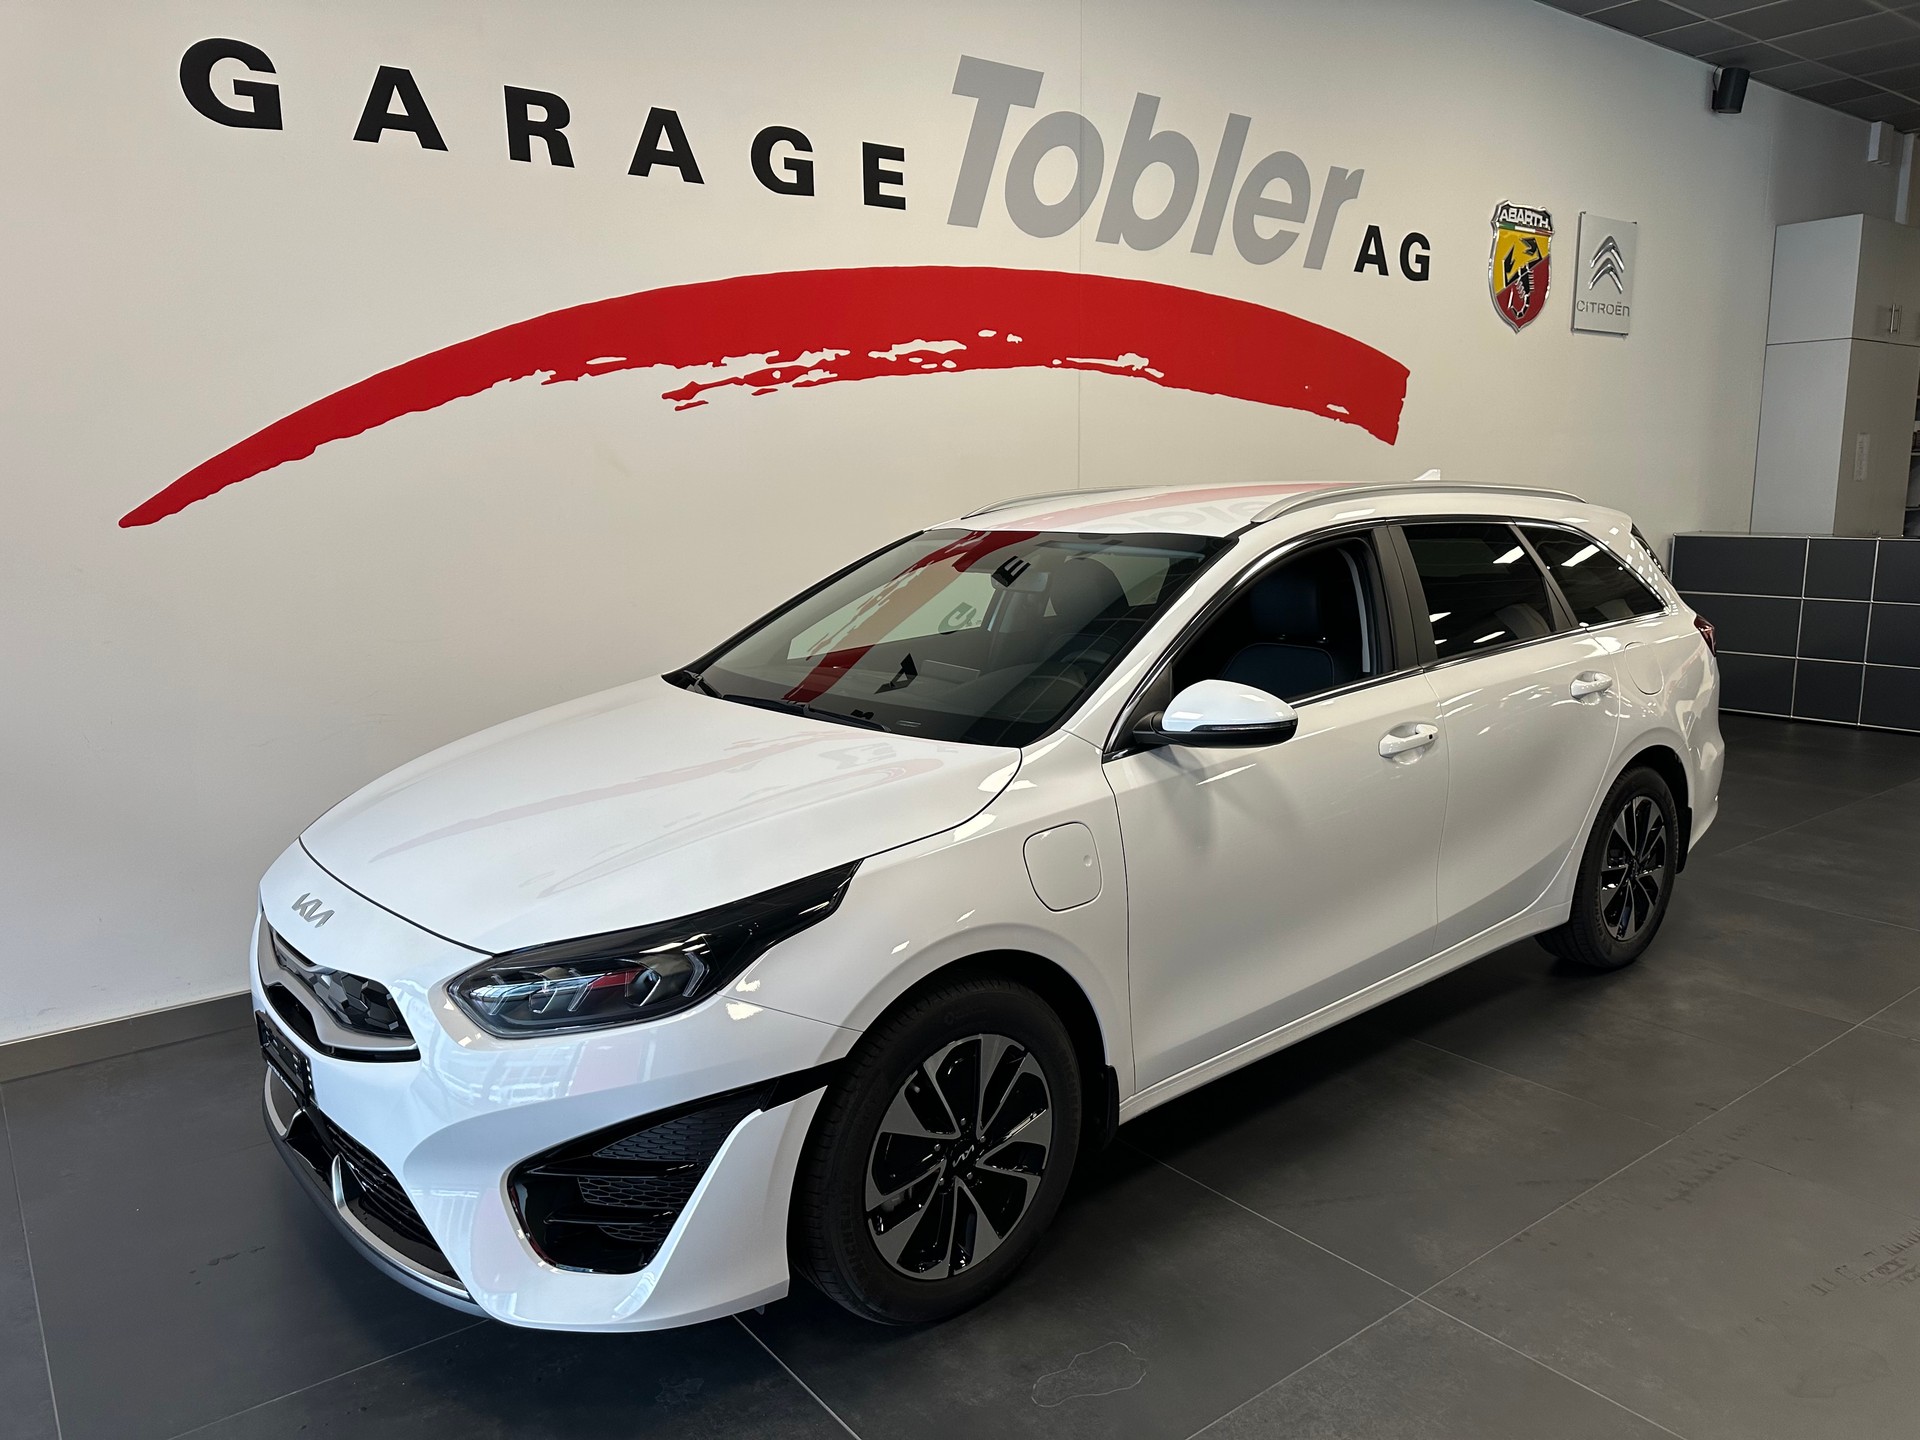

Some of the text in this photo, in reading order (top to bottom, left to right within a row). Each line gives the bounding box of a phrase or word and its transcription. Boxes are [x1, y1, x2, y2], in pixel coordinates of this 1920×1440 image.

[179, 37, 1432, 282] GARAGE Tobler AG
[1499, 207, 1550, 229] ABARTH
